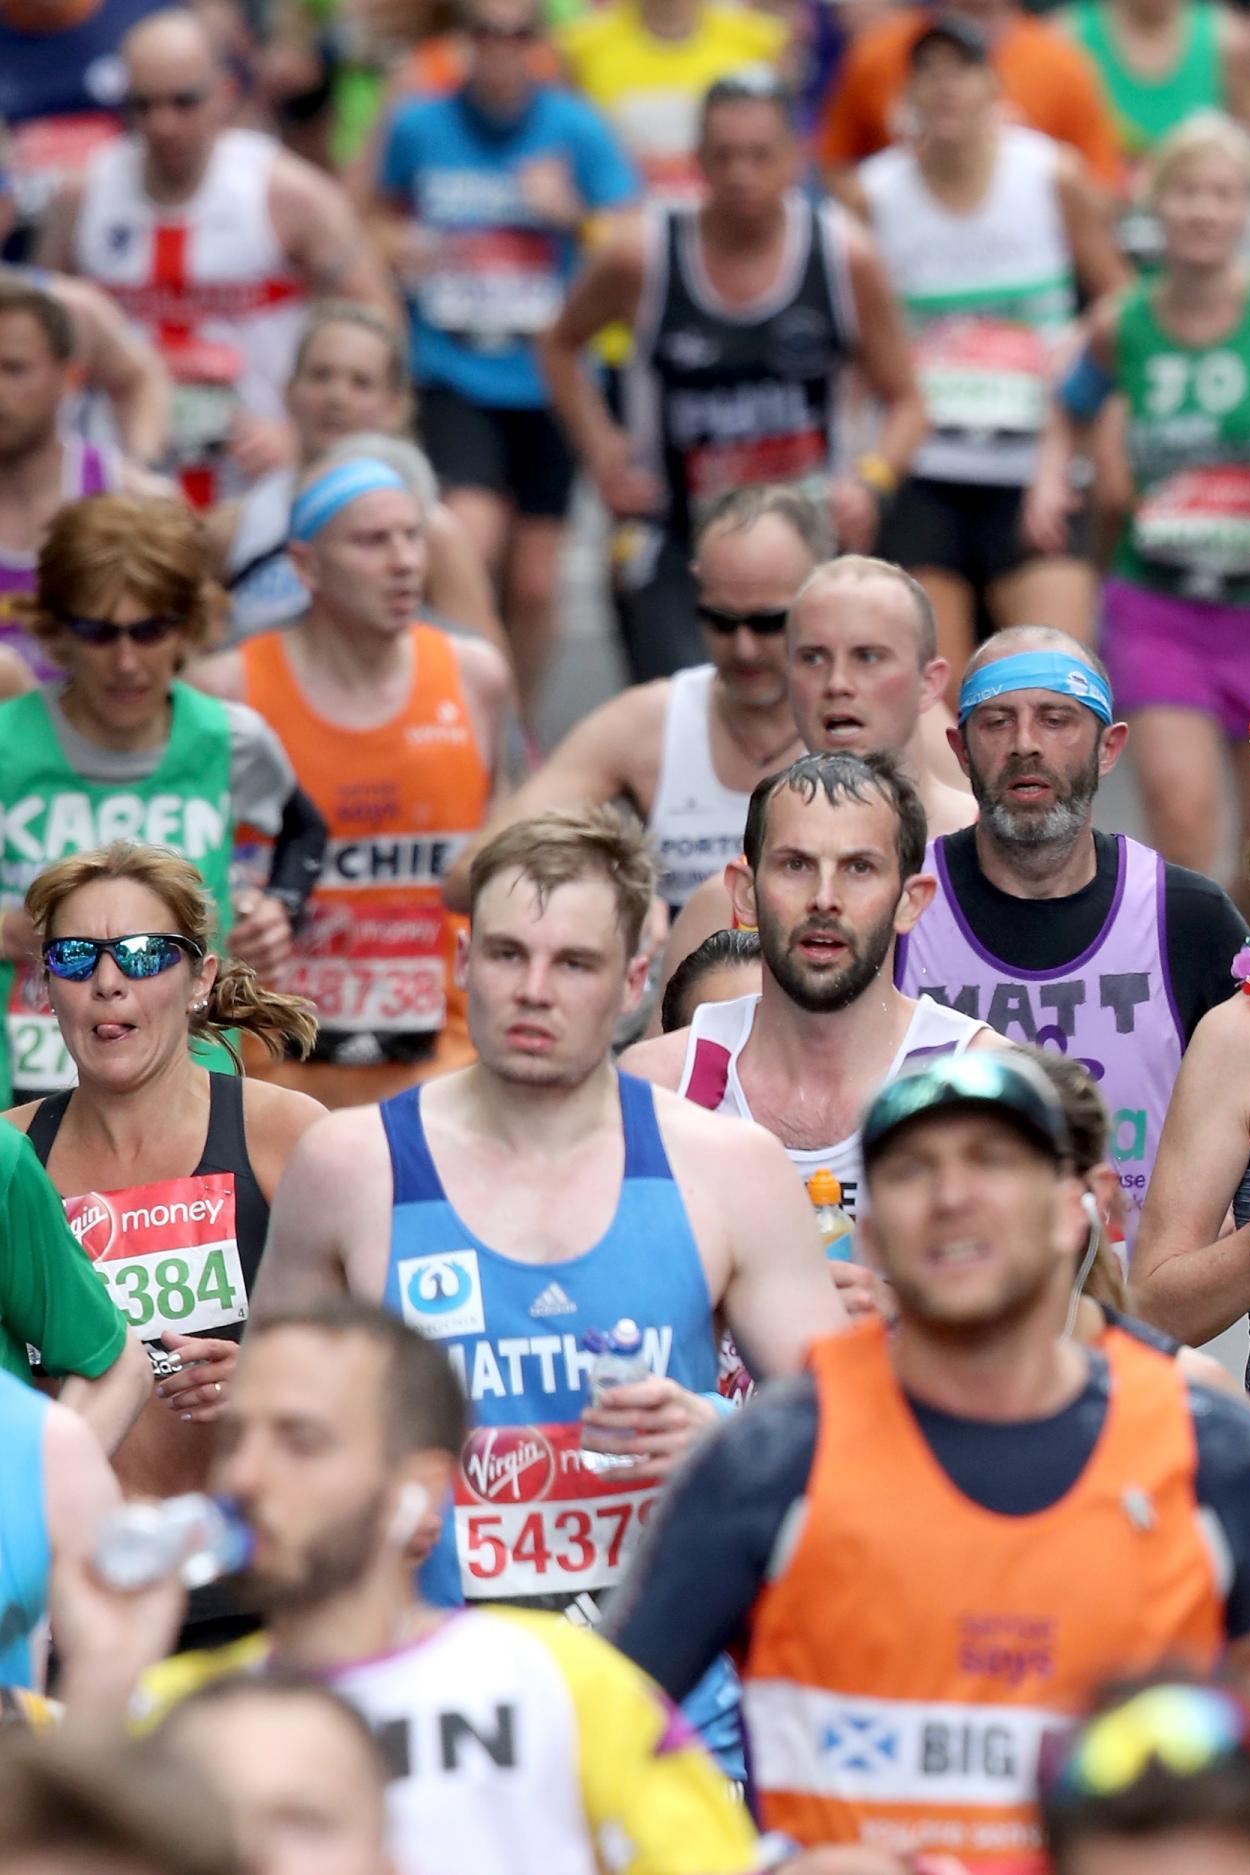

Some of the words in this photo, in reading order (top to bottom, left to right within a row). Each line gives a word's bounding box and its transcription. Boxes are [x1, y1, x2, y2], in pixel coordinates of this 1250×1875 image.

[0, 790, 231, 860] KAREN
[917, 972, 1151, 1043] MATT
[122, 1199, 224, 1233] money
[94, 1248, 236, 1327] 384
[447, 1325, 673, 1400] ATTHW
[467, 1428, 547, 1499] Virgin
[920, 1719, 1016, 1779] BIG
